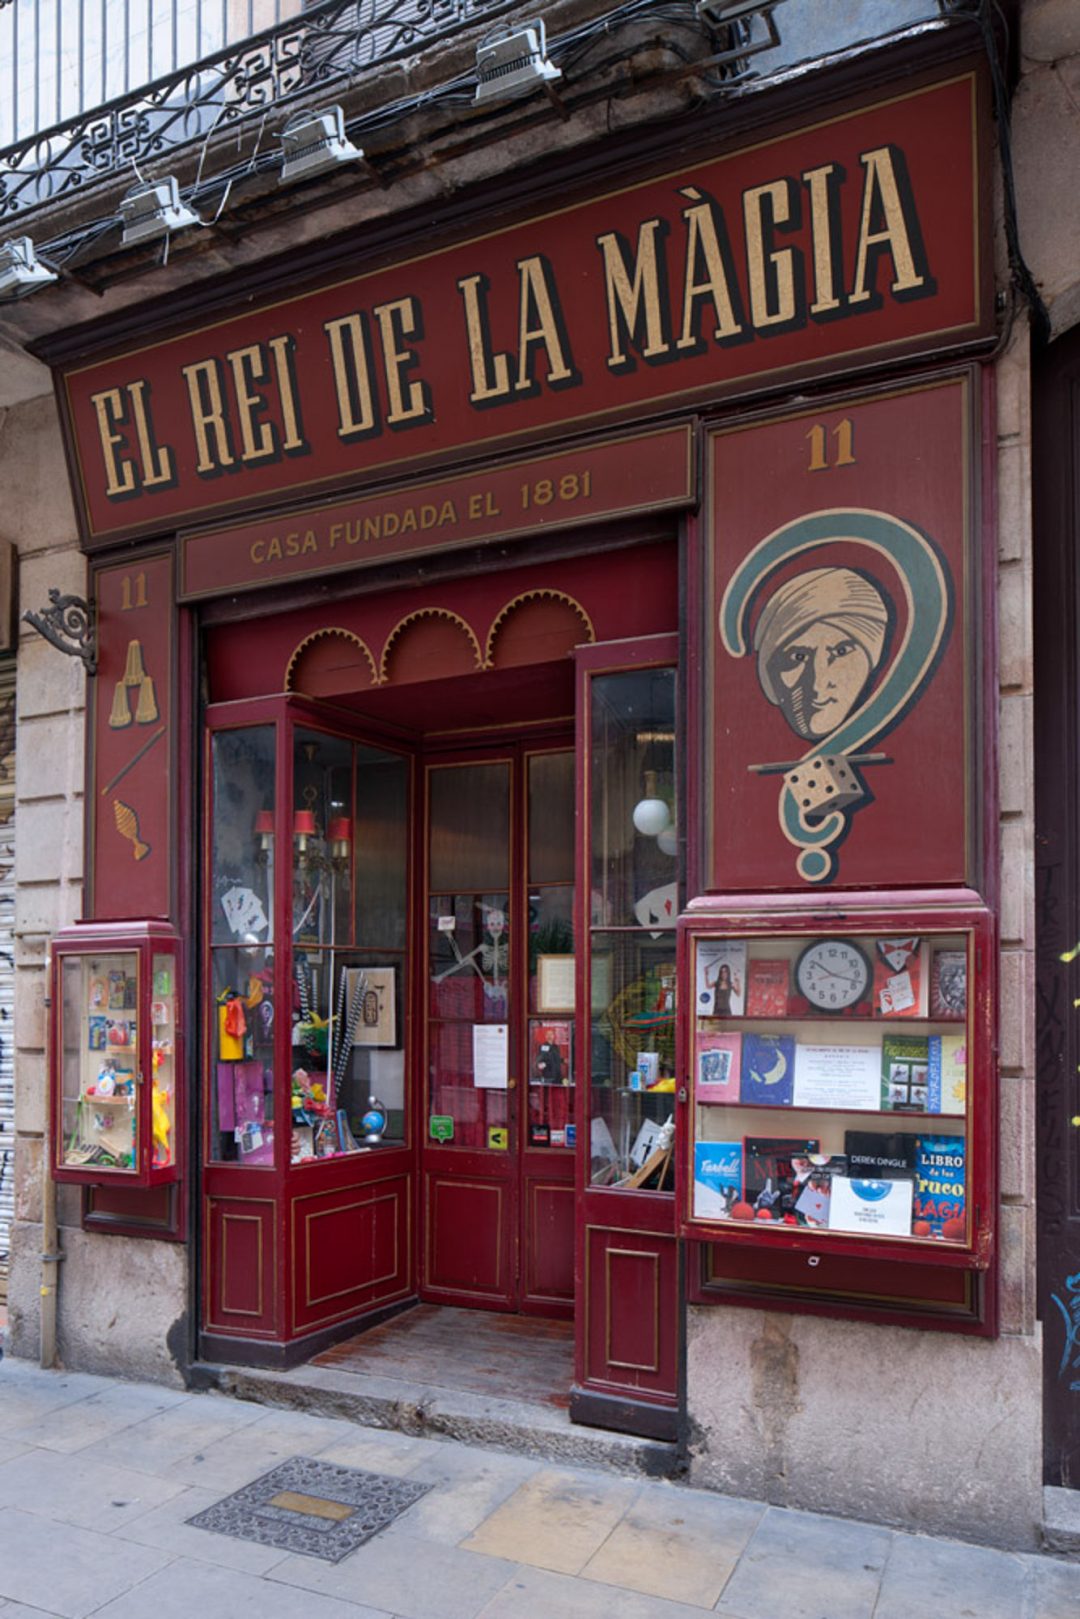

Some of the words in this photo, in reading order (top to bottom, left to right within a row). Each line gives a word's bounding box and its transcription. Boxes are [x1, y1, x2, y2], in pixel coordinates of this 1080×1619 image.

[91, 380, 175, 498] EL
[183, 334, 306, 476] REI
[325, 297, 428, 440] DE
[458, 256, 576, 404] LA
[597, 146, 928, 368] MÀGIA
[805, 418, 857, 471] 11
[250, 530, 318, 565] CASA
[329, 500, 459, 549] FUNDADA
[468, 493, 501, 521] EL
[520, 470, 593, 510] 1881
[120, 572, 149, 610] 11
[850, 1155, 876, 1166] DEREK
[877, 1157, 907, 1169] DINGLE
[921, 1154, 963, 1167] LIBRO
